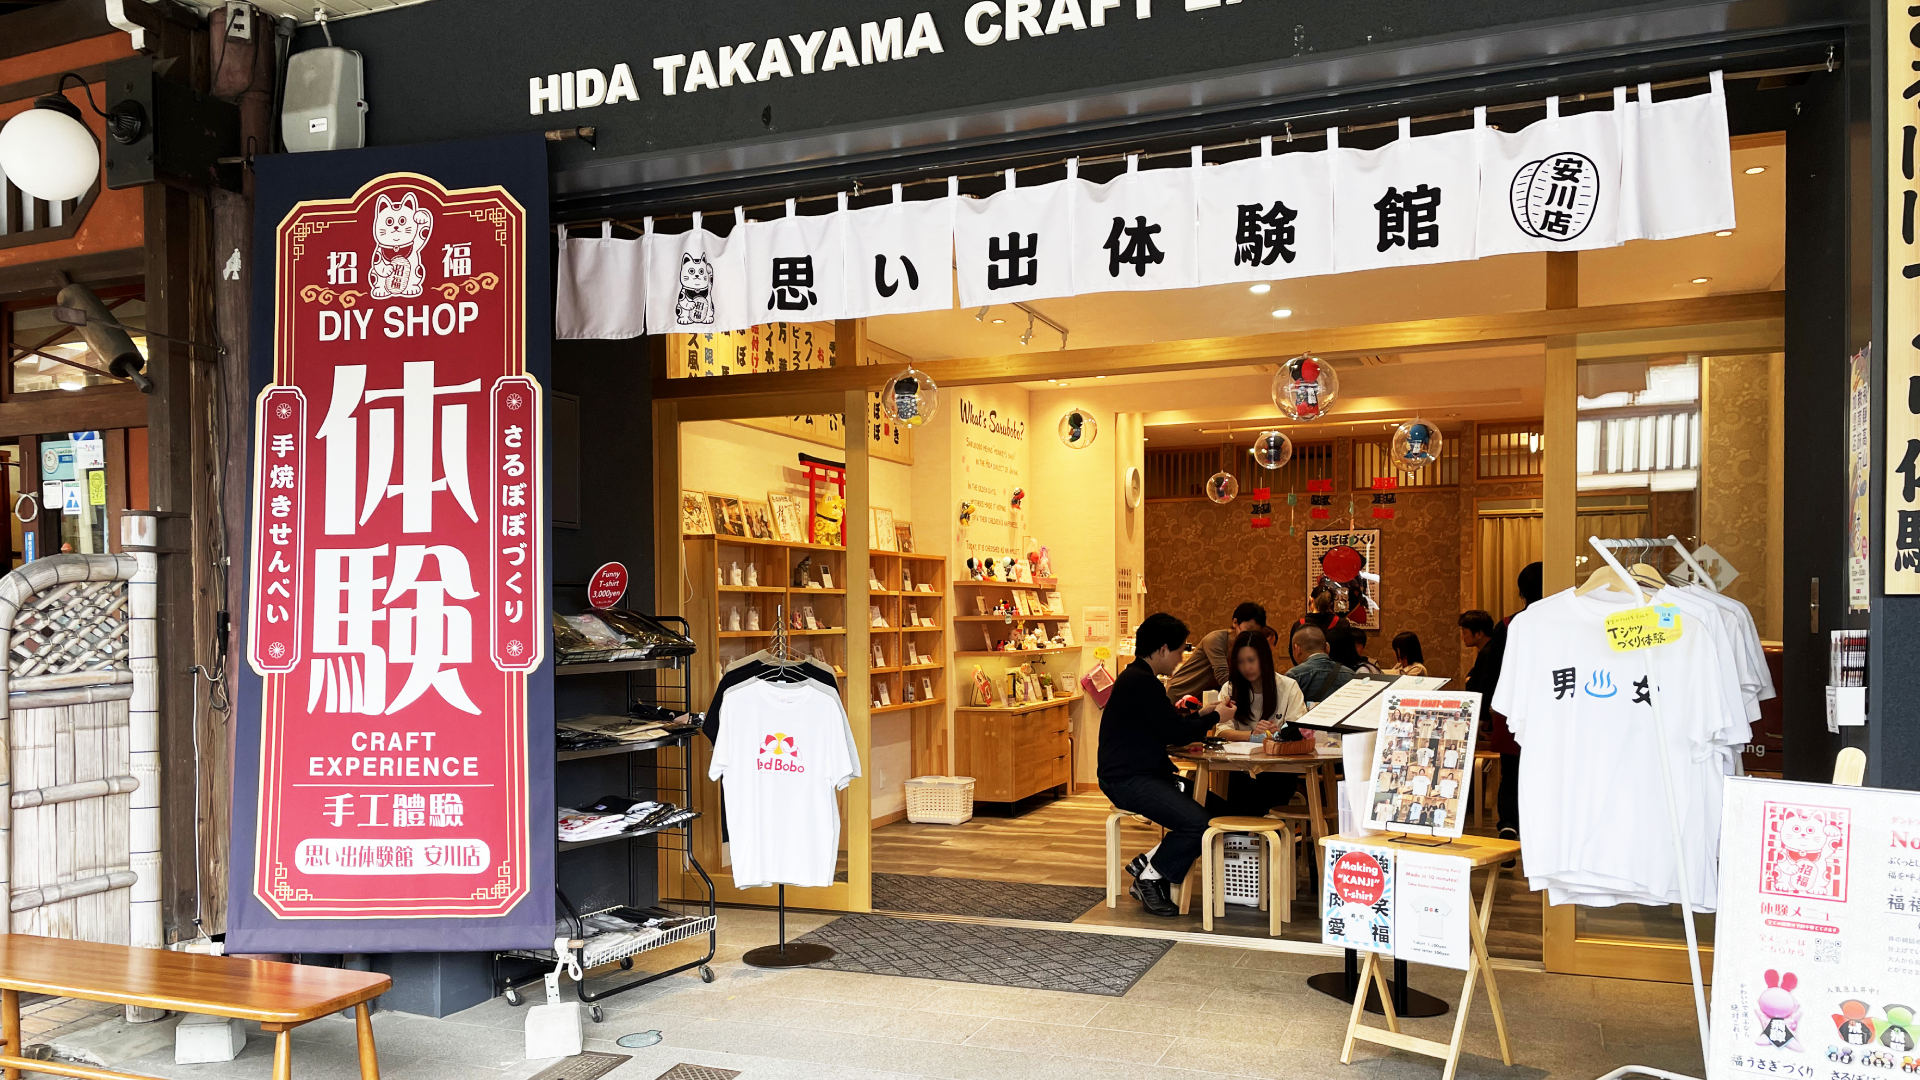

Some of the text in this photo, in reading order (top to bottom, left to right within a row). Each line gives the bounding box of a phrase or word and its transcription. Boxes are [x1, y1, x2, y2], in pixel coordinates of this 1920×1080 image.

[529, 62, 640, 116] HIDA
[653, 12, 944, 96] TAKAYAMA
[1539, 156, 1584, 236] 安川店
[327, 242, 472, 285] 招 福
[767, 184, 1441, 311] 思い出体験館
[318, 301, 479, 342] DIY SHOP
[960, 397, 987, 429] What's
[266, 433, 295, 624] 手焼きせんべい
[307, 361, 483, 716] 体験
[501, 424, 528, 624] さるぼぼづくり
[602, 571, 620, 579] Funny
[592, 590, 620, 598] 3,000yen
[1552, 667, 1576, 700] 男
[351, 731, 436, 752] CRAFT
[309, 757, 479, 777] EXPERIENCE
[775, 758, 804, 773] Bobo
[322, 792, 465, 828] 手工體驗
[304, 844, 481, 868] 思い出体験館 安川店
[1340, 861, 1378, 876] Making
[1343, 888, 1373, 901] T-shirt
[1329, 917, 1345, 936] 愛
[1372, 924, 1389, 943] 福
